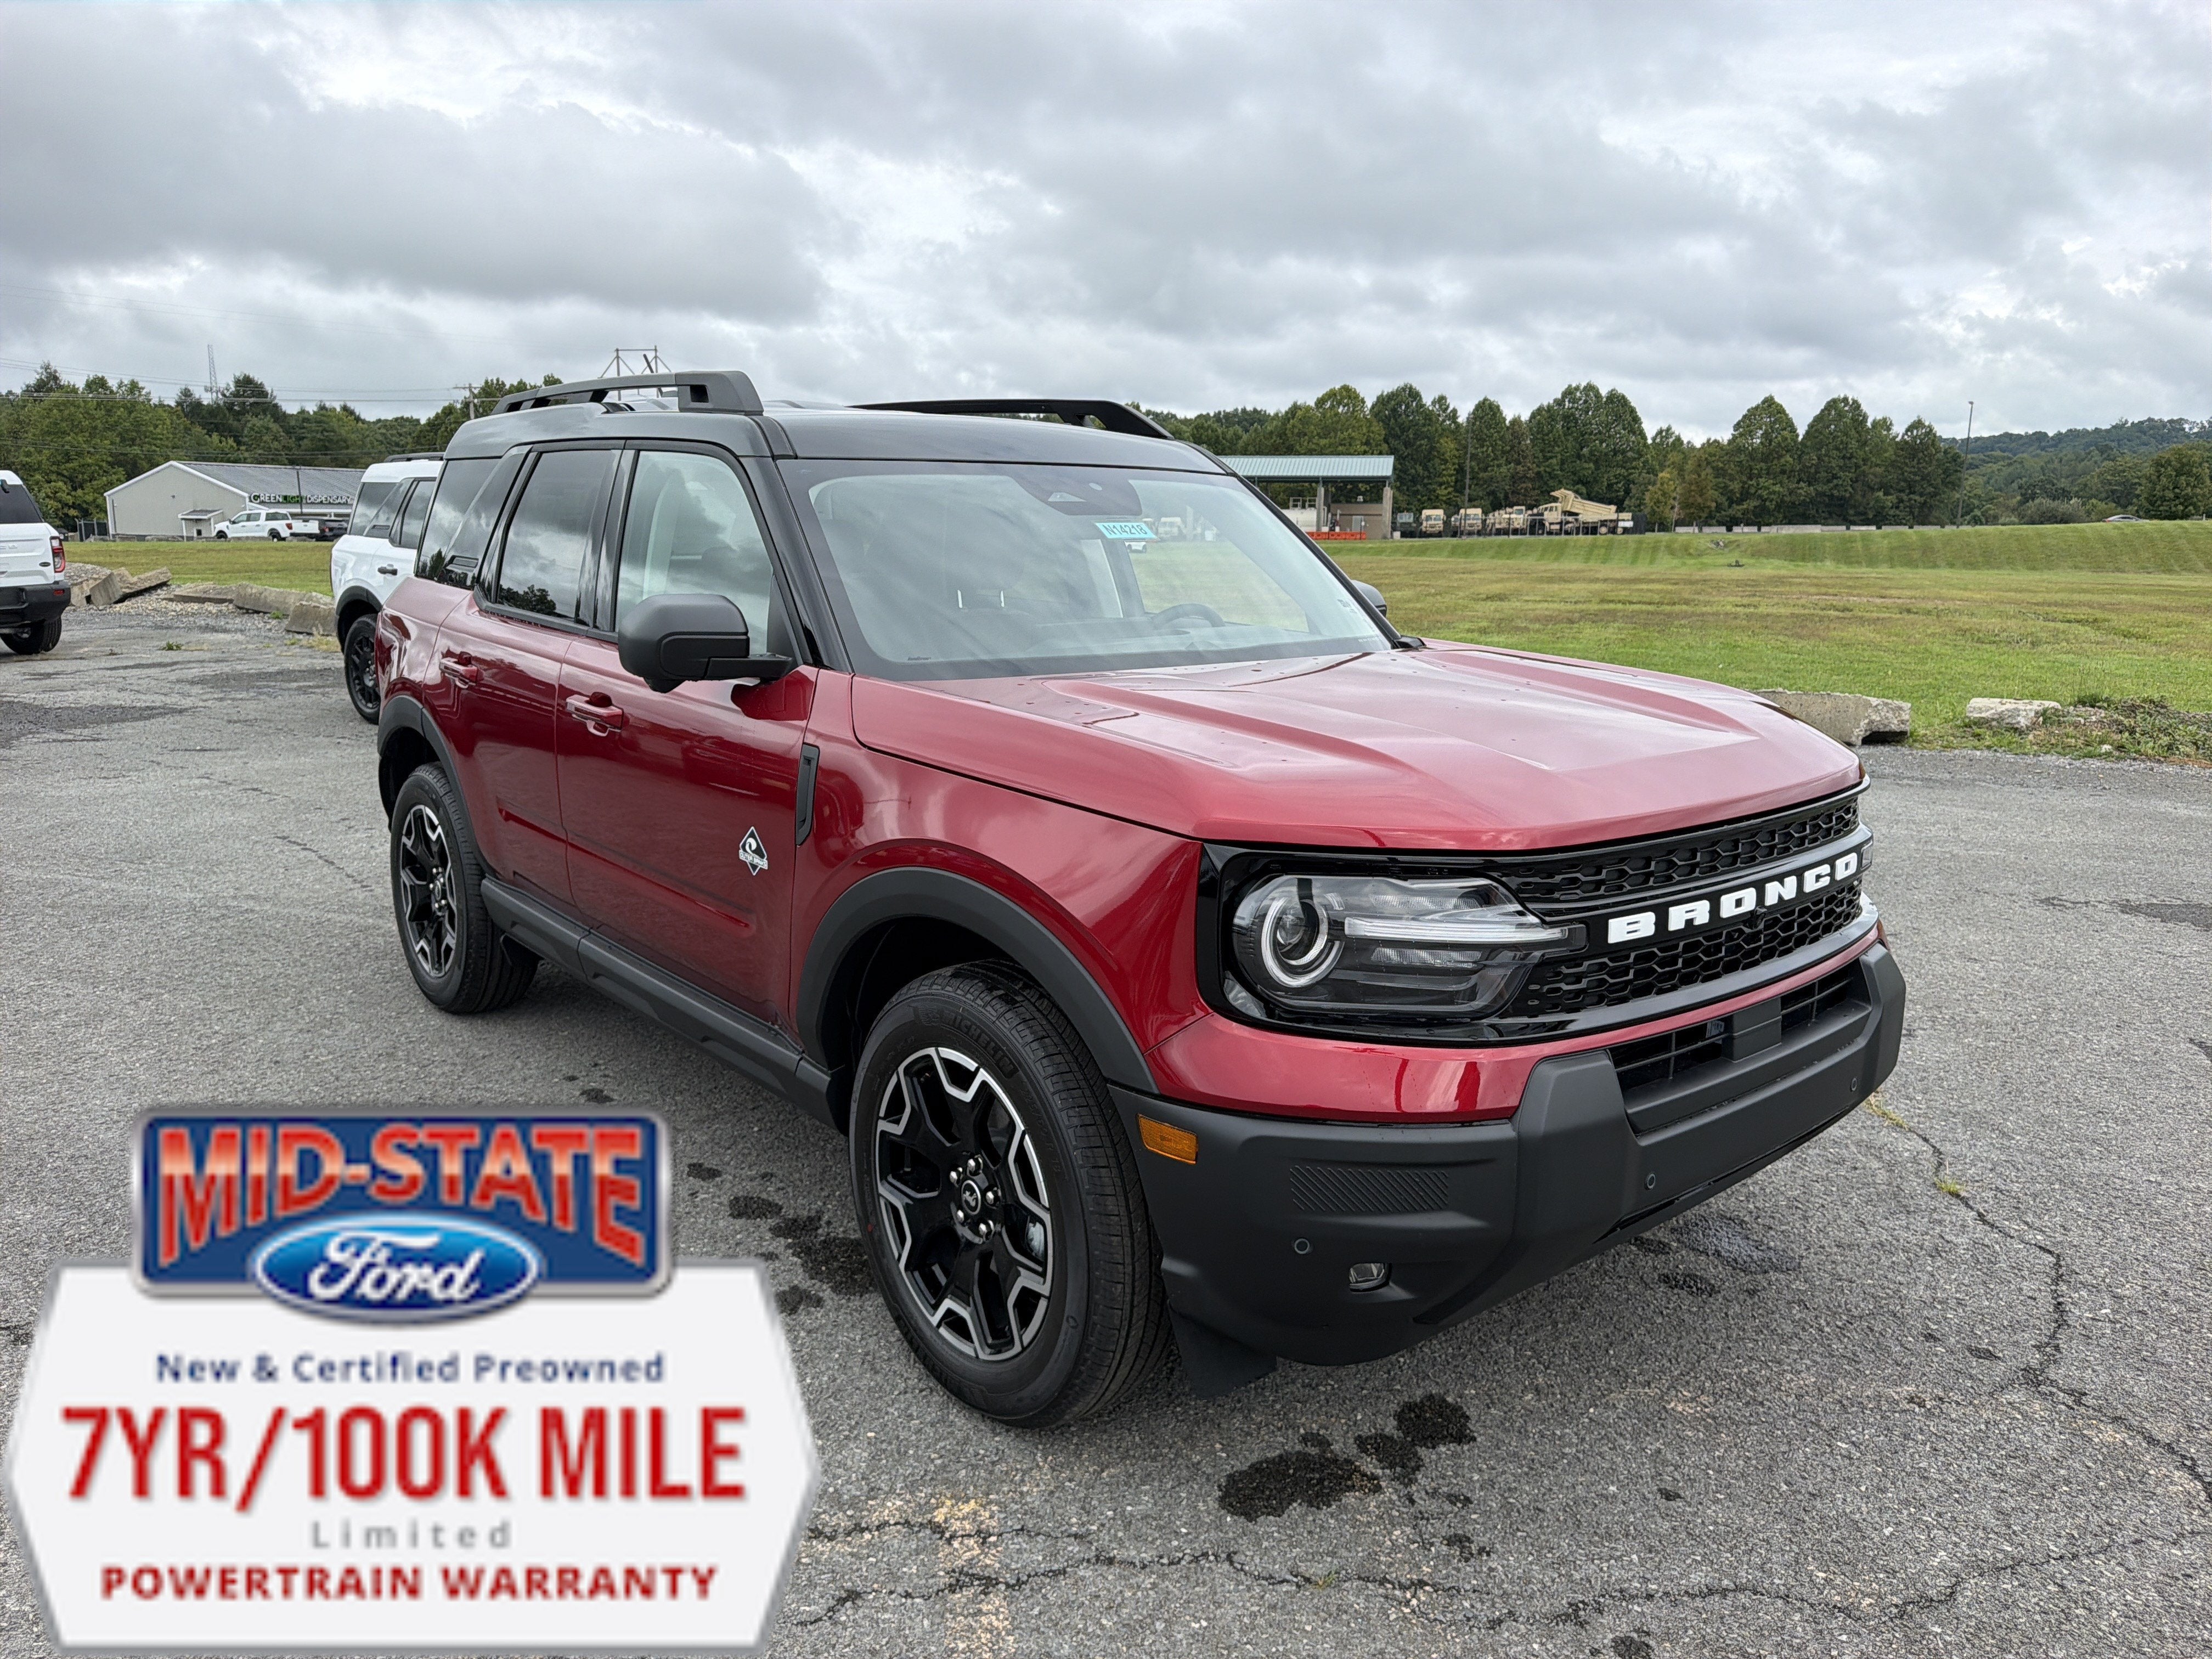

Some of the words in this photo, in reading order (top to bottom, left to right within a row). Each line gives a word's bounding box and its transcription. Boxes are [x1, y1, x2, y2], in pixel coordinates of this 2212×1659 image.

[307, 494, 352, 504] DISPENSARY
[1102, 524, 1148, 535] N14218
[1607, 852, 1858, 944] BRONCO
[940, 1010, 1014, 1074] MICHELIN
